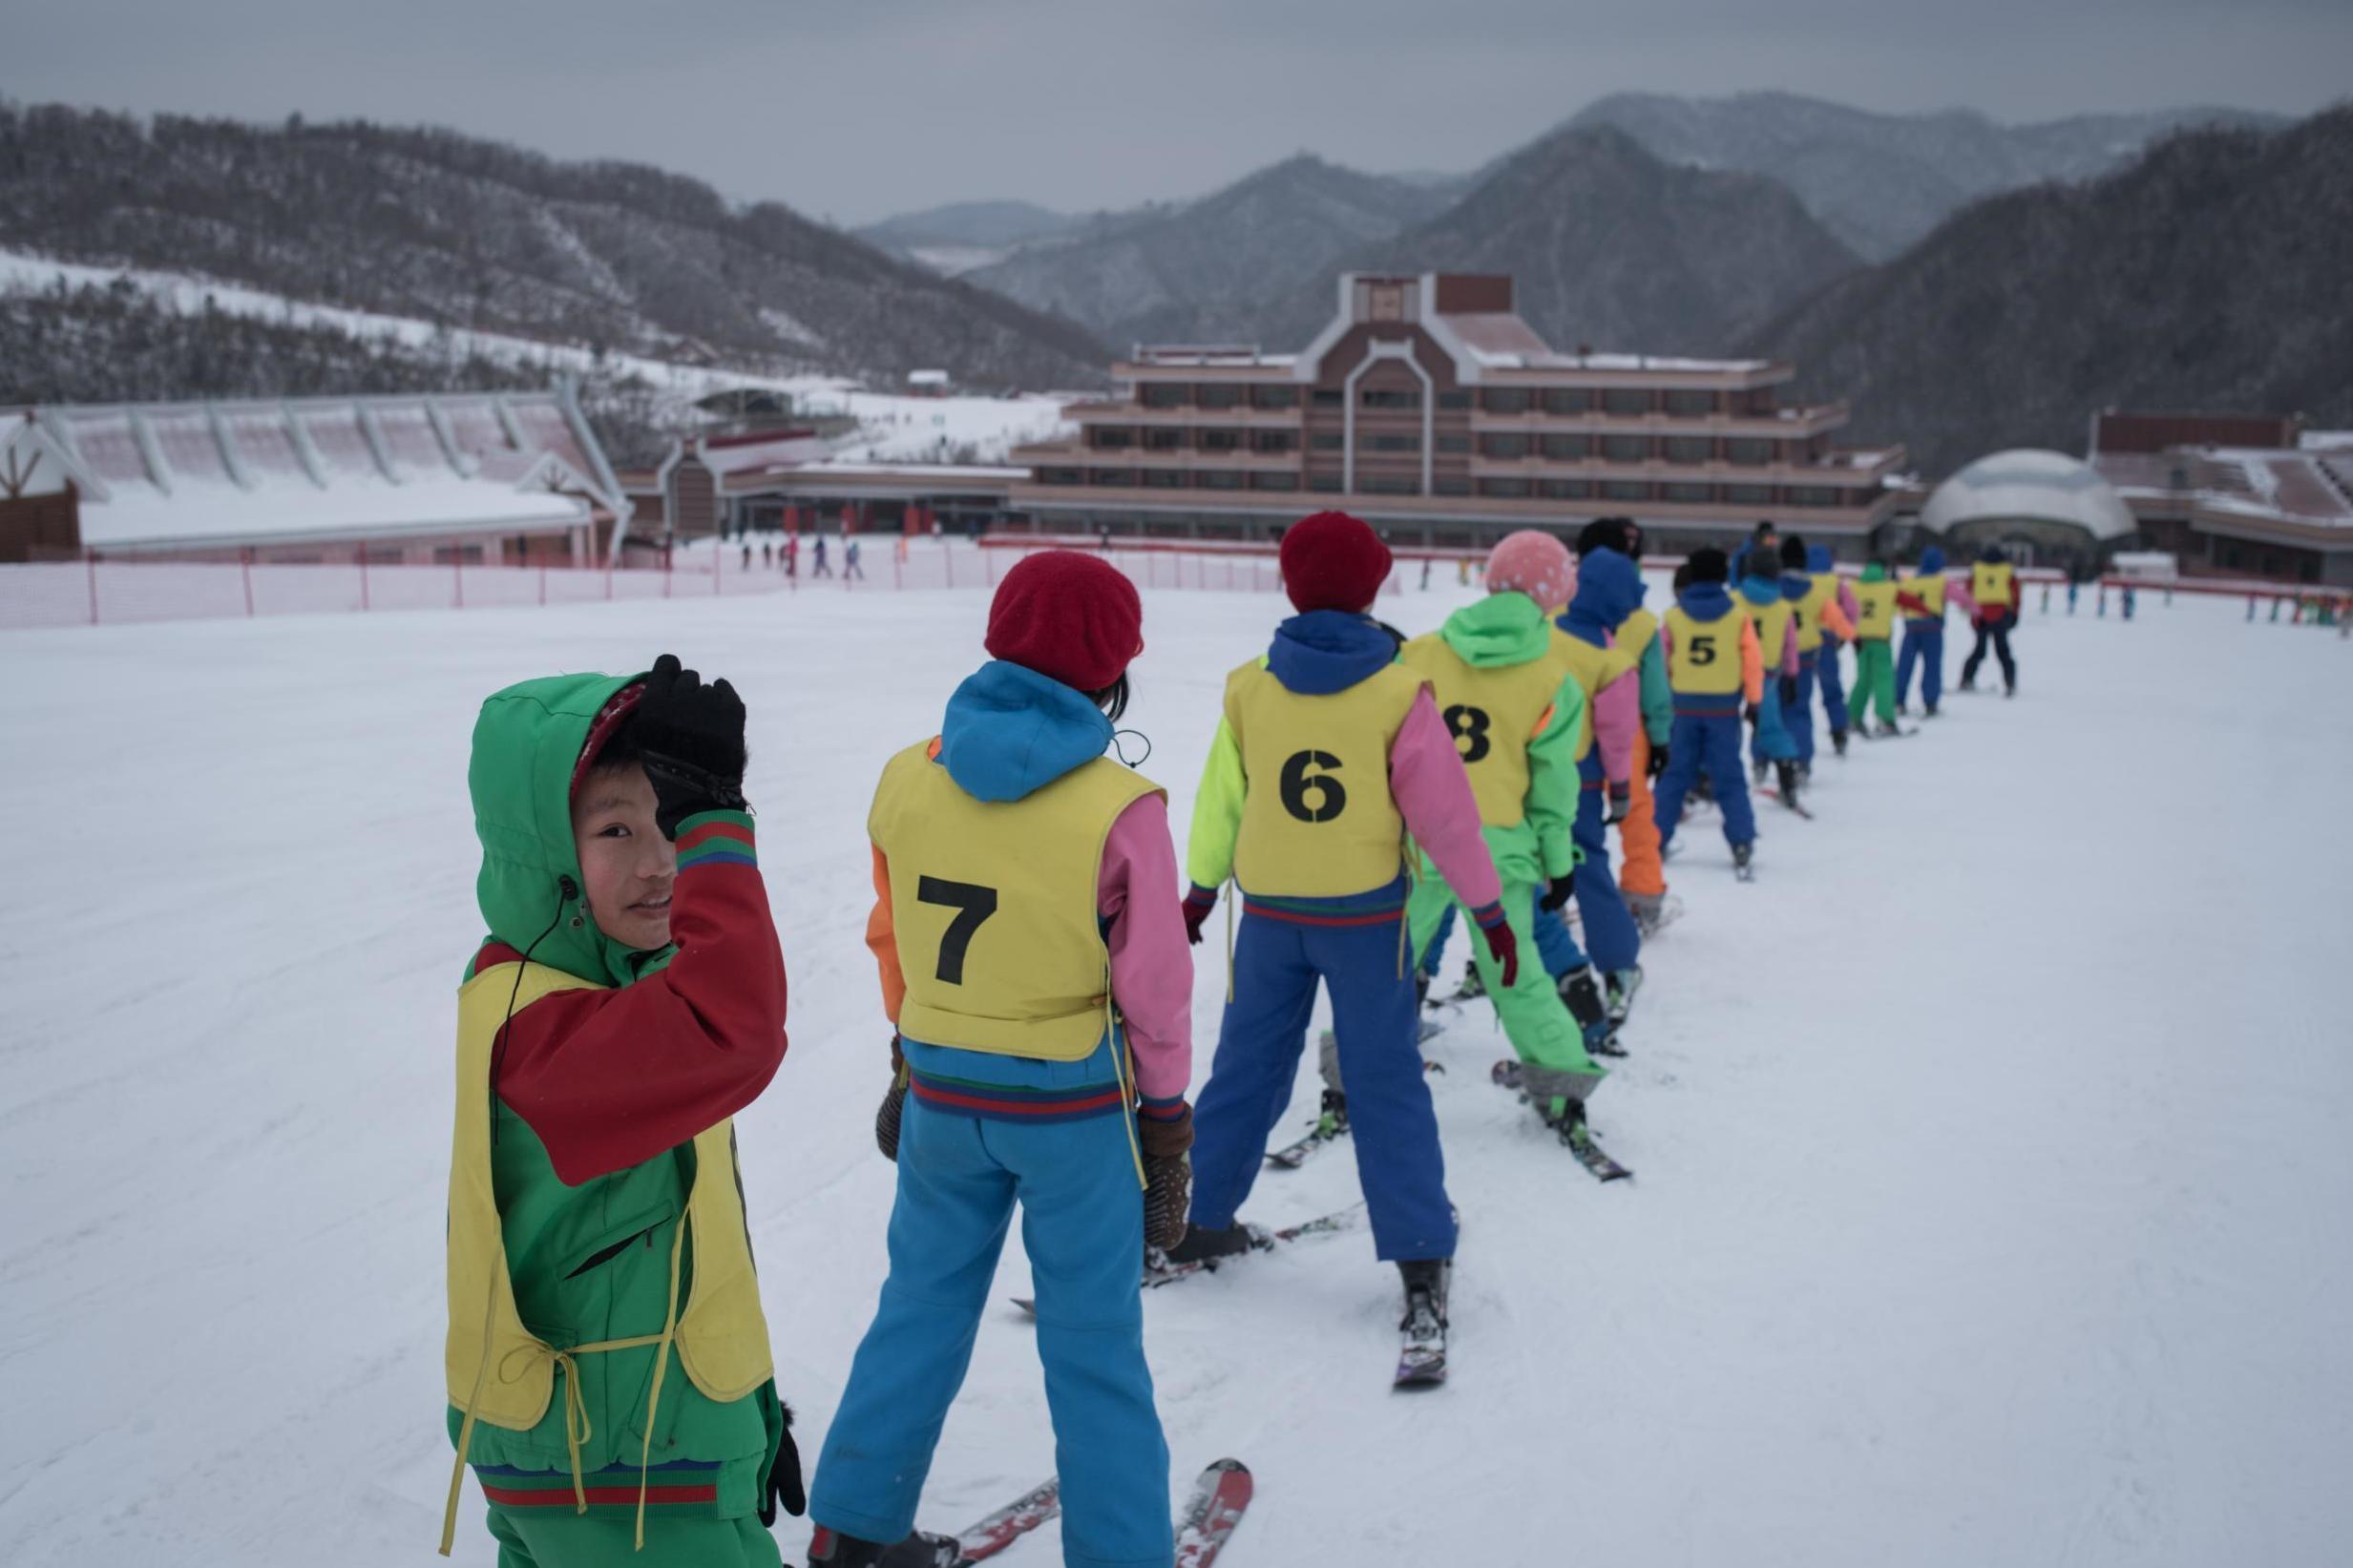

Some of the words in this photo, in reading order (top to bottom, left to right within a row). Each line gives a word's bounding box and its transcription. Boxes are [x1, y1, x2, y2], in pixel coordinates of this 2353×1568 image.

[1689, 636, 1716, 667] 5
[1442, 704, 1491, 763] 8
[1280, 749, 1347, 824] 6
[917, 874, 998, 986] 7
